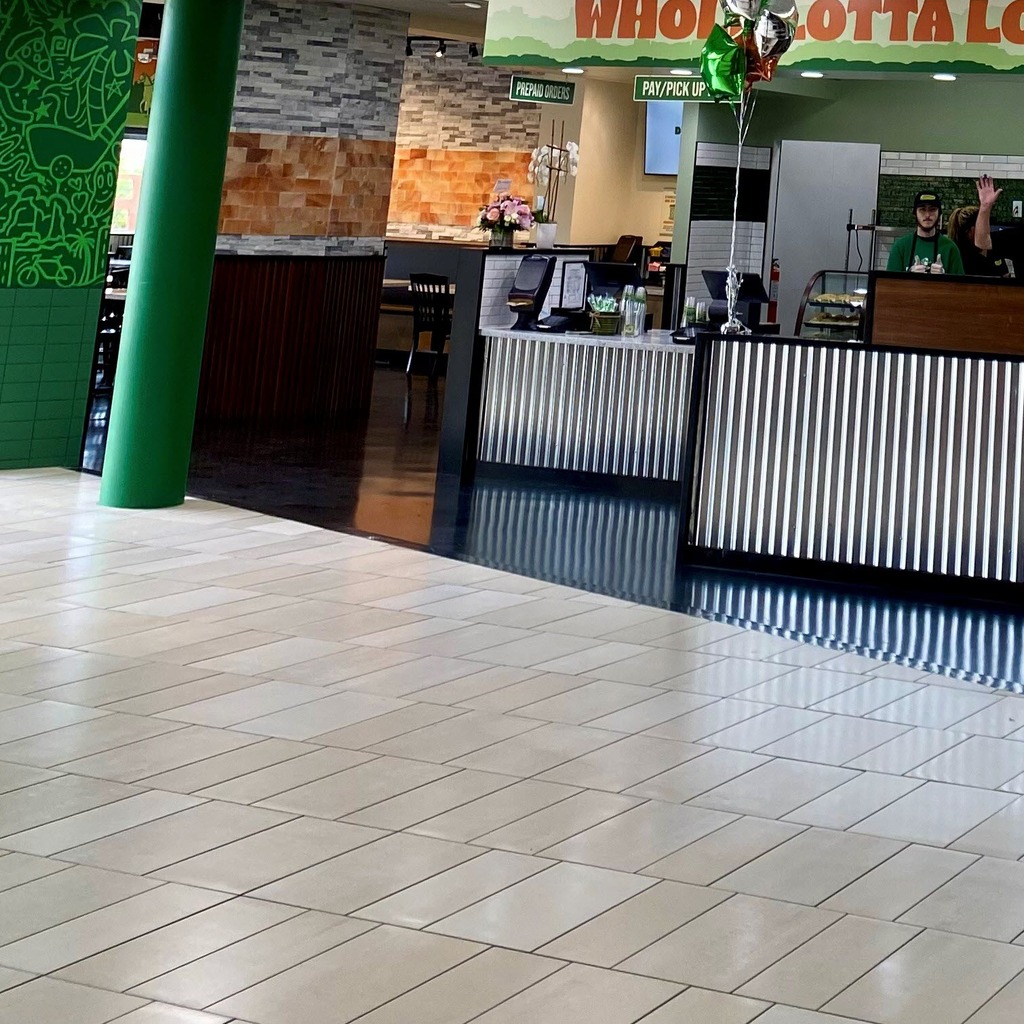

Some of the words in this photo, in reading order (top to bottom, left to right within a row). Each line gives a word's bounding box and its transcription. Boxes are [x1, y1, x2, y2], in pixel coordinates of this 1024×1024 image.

[515, 81, 544, 98] PREPAID
[544, 84, 570, 101] ORDERS
[642, 80, 690, 97] PAY/PICK
[691, 81, 706, 97] UP
